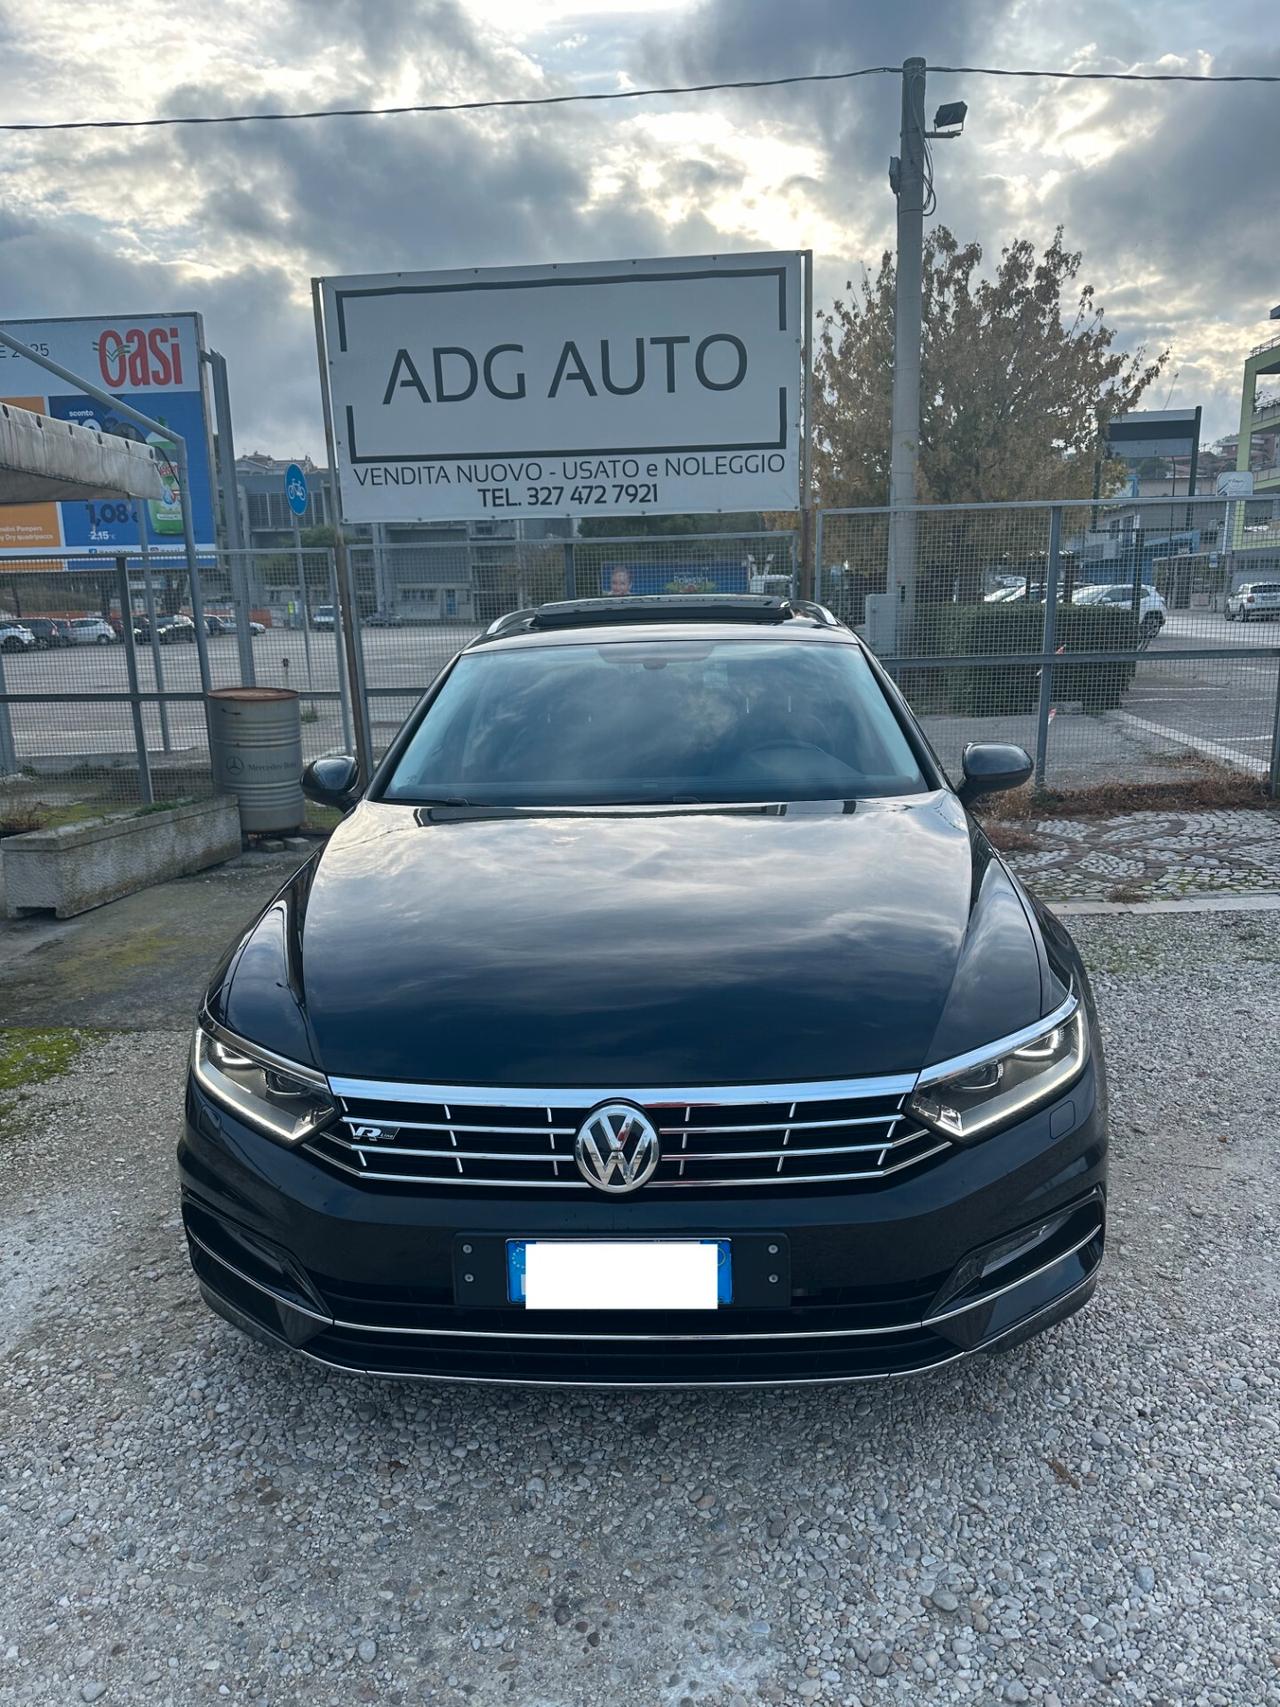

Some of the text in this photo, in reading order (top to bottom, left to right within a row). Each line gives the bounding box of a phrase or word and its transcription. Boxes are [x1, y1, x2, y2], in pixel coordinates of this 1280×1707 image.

[382, 333, 748, 405] ADG AUTO
[353, 465, 451, 486] VENDITA
[457, 462, 543, 483] NUOVO
[562, 459, 640, 480] USATO
[646, 463, 658, 477] e
[665, 453, 785, 477] NOLEGGIO
[477, 483, 658, 508] TEL. 327 472 7921
